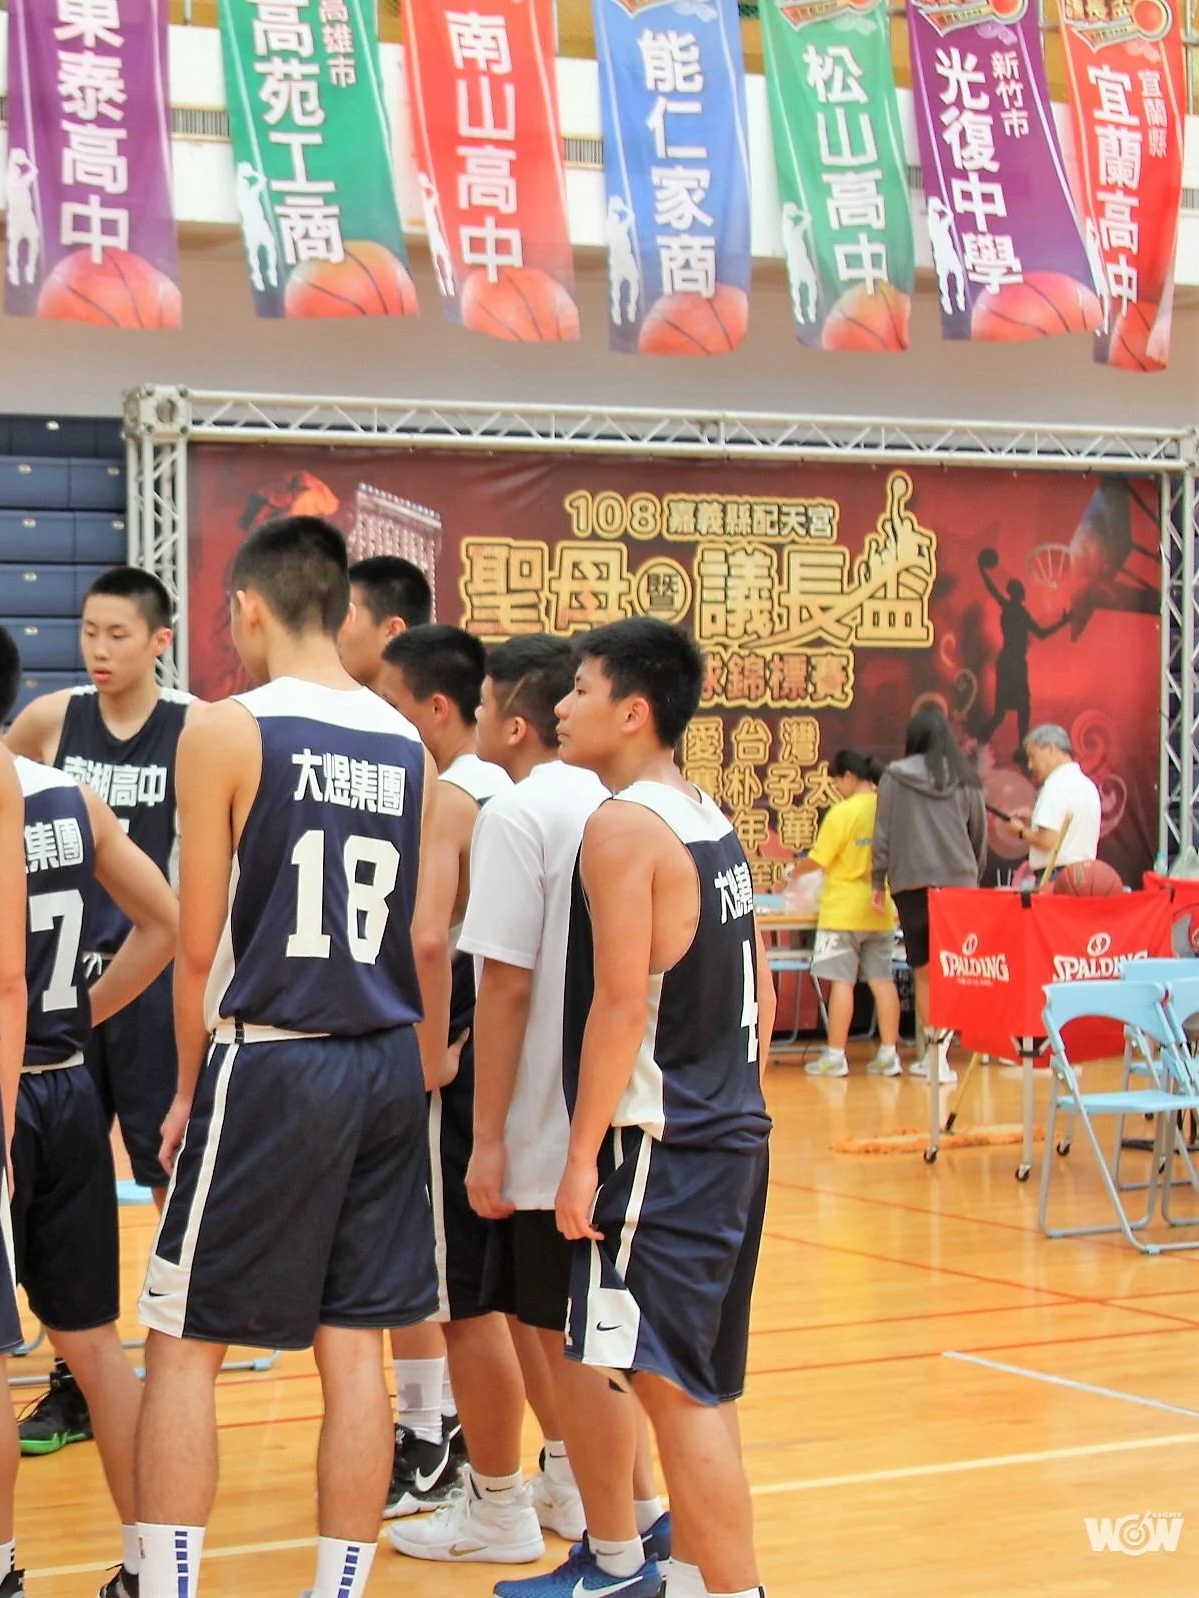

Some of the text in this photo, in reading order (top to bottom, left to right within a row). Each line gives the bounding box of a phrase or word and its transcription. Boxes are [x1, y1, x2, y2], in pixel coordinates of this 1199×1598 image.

[250, 0, 346, 265] 高苑工商
[443, 10, 525, 285] 南山高中
[990, 49, 1030, 139] 新竹市
[1137, 69, 1167, 159] 宜蘭縣
[636, 27, 717, 300] 能仁家商
[802, 43, 890, 298] 松山高中
[934, 46, 1025, 295] 光復中學
[1087, 64, 1143, 319] 宜蘭高中
[25, 817, 84, 874] 集團
[292, 748, 406, 817] 大煜集團
[286, 829, 401, 965] 18
[939, 949, 1010, 983] SPALDING
[1052, 950, 1148, 983] SPALDI
